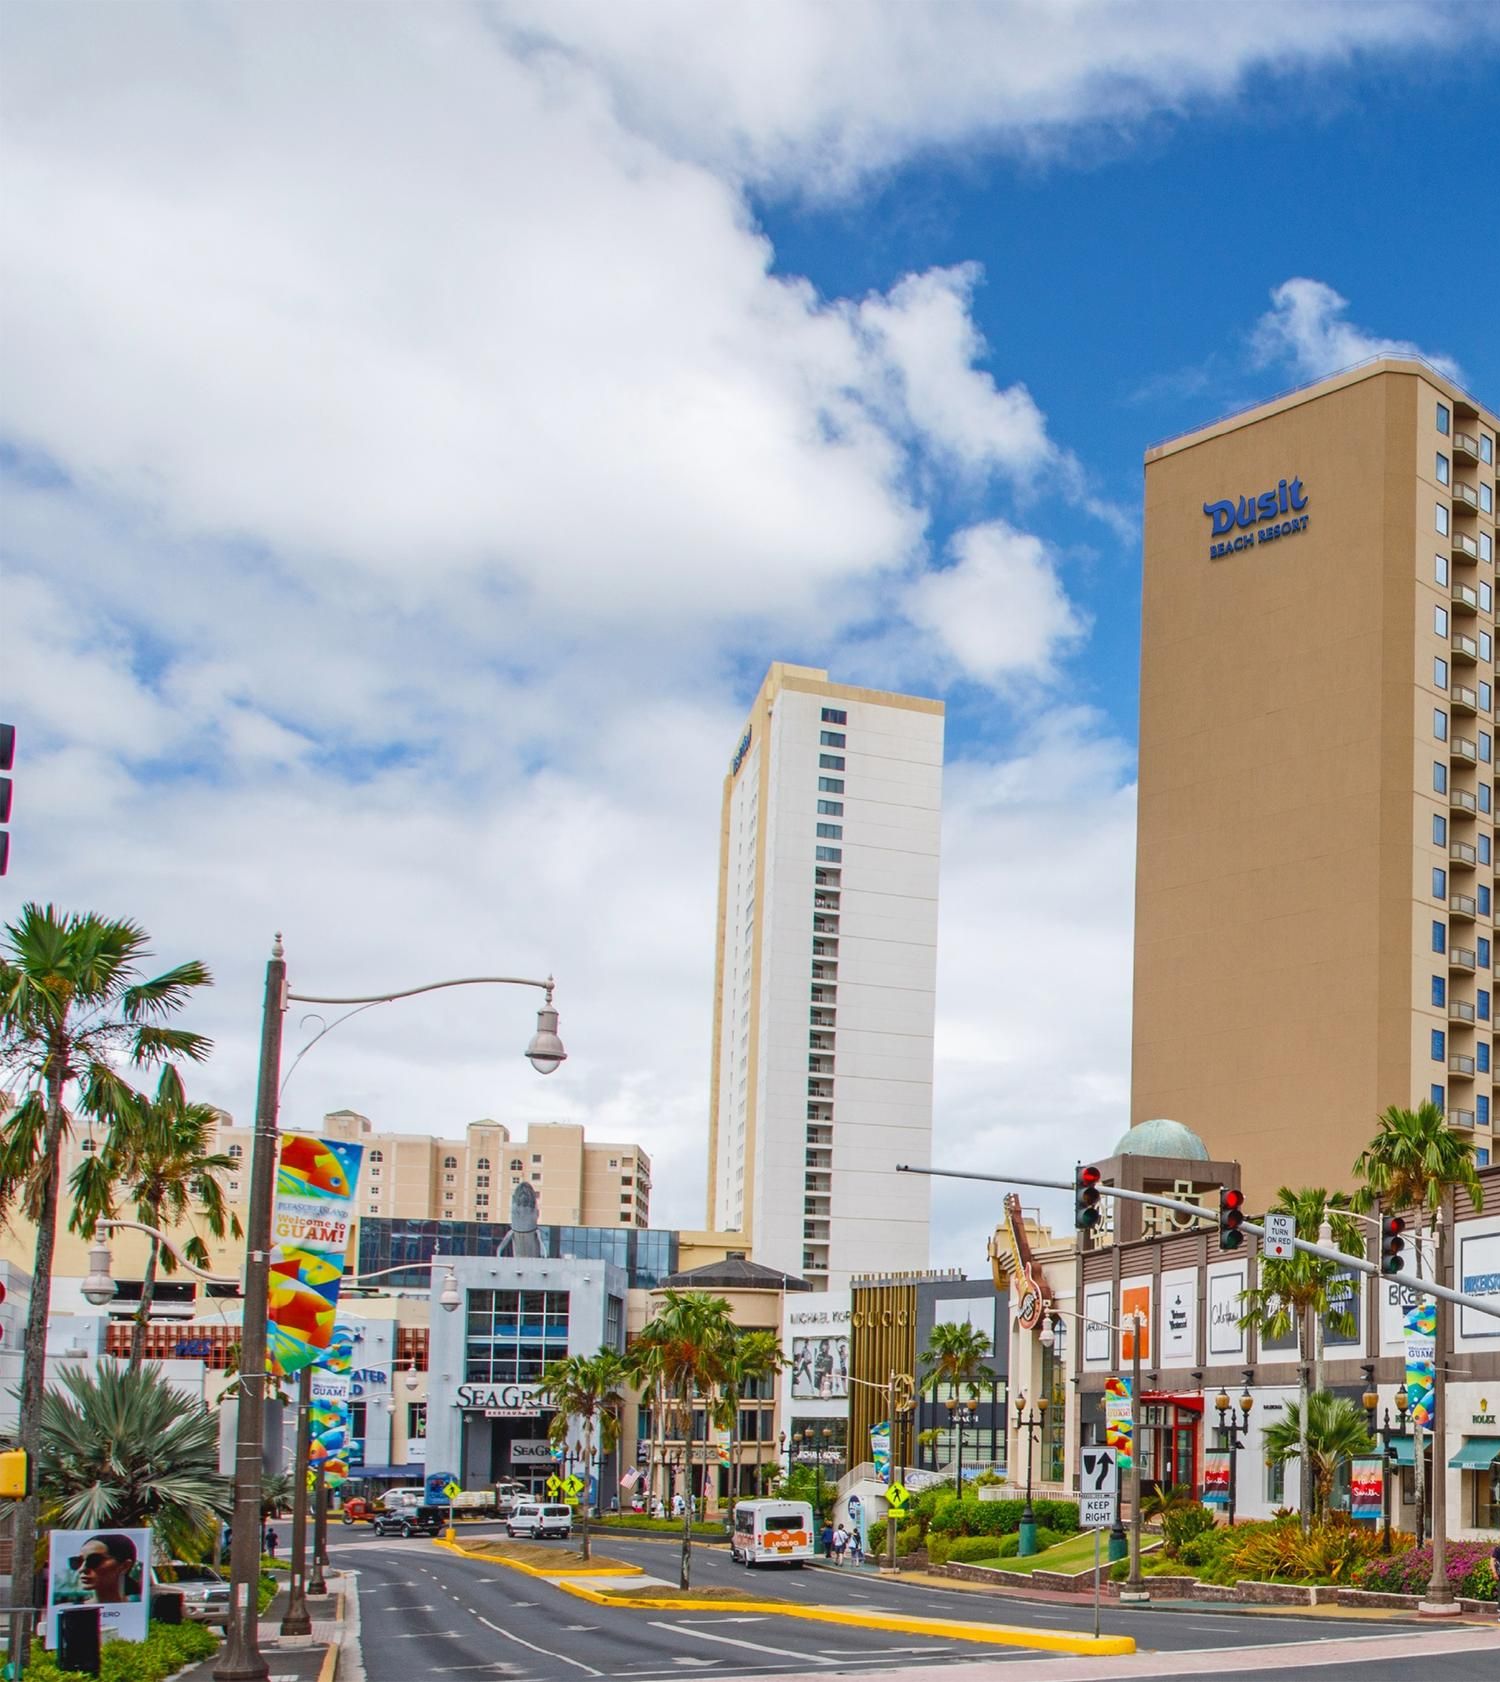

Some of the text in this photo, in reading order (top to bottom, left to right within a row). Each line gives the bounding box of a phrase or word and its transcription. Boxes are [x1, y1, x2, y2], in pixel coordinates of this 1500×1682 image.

[1203, 475, 1309, 538] Dusit
[1210, 515, 1310, 561] BEACH RESORT
[278, 1214, 346, 1230] Welcome to
[1273, 1217, 1287, 1227] NO
[276, 1223, 345, 1243] GUAM!
[1271, 1228, 1289, 1236] TURN
[1267, 1236, 1291, 1245] ON RED
[852, 1310, 917, 1328] GUCCI
[1472, 1415, 1496, 1424] ROLEX
[1353, 1487, 1381, 1497] Smith
[1087, 1501, 1110, 1510] KEEP
[1085, 1512, 1111, 1522] RIGHT
